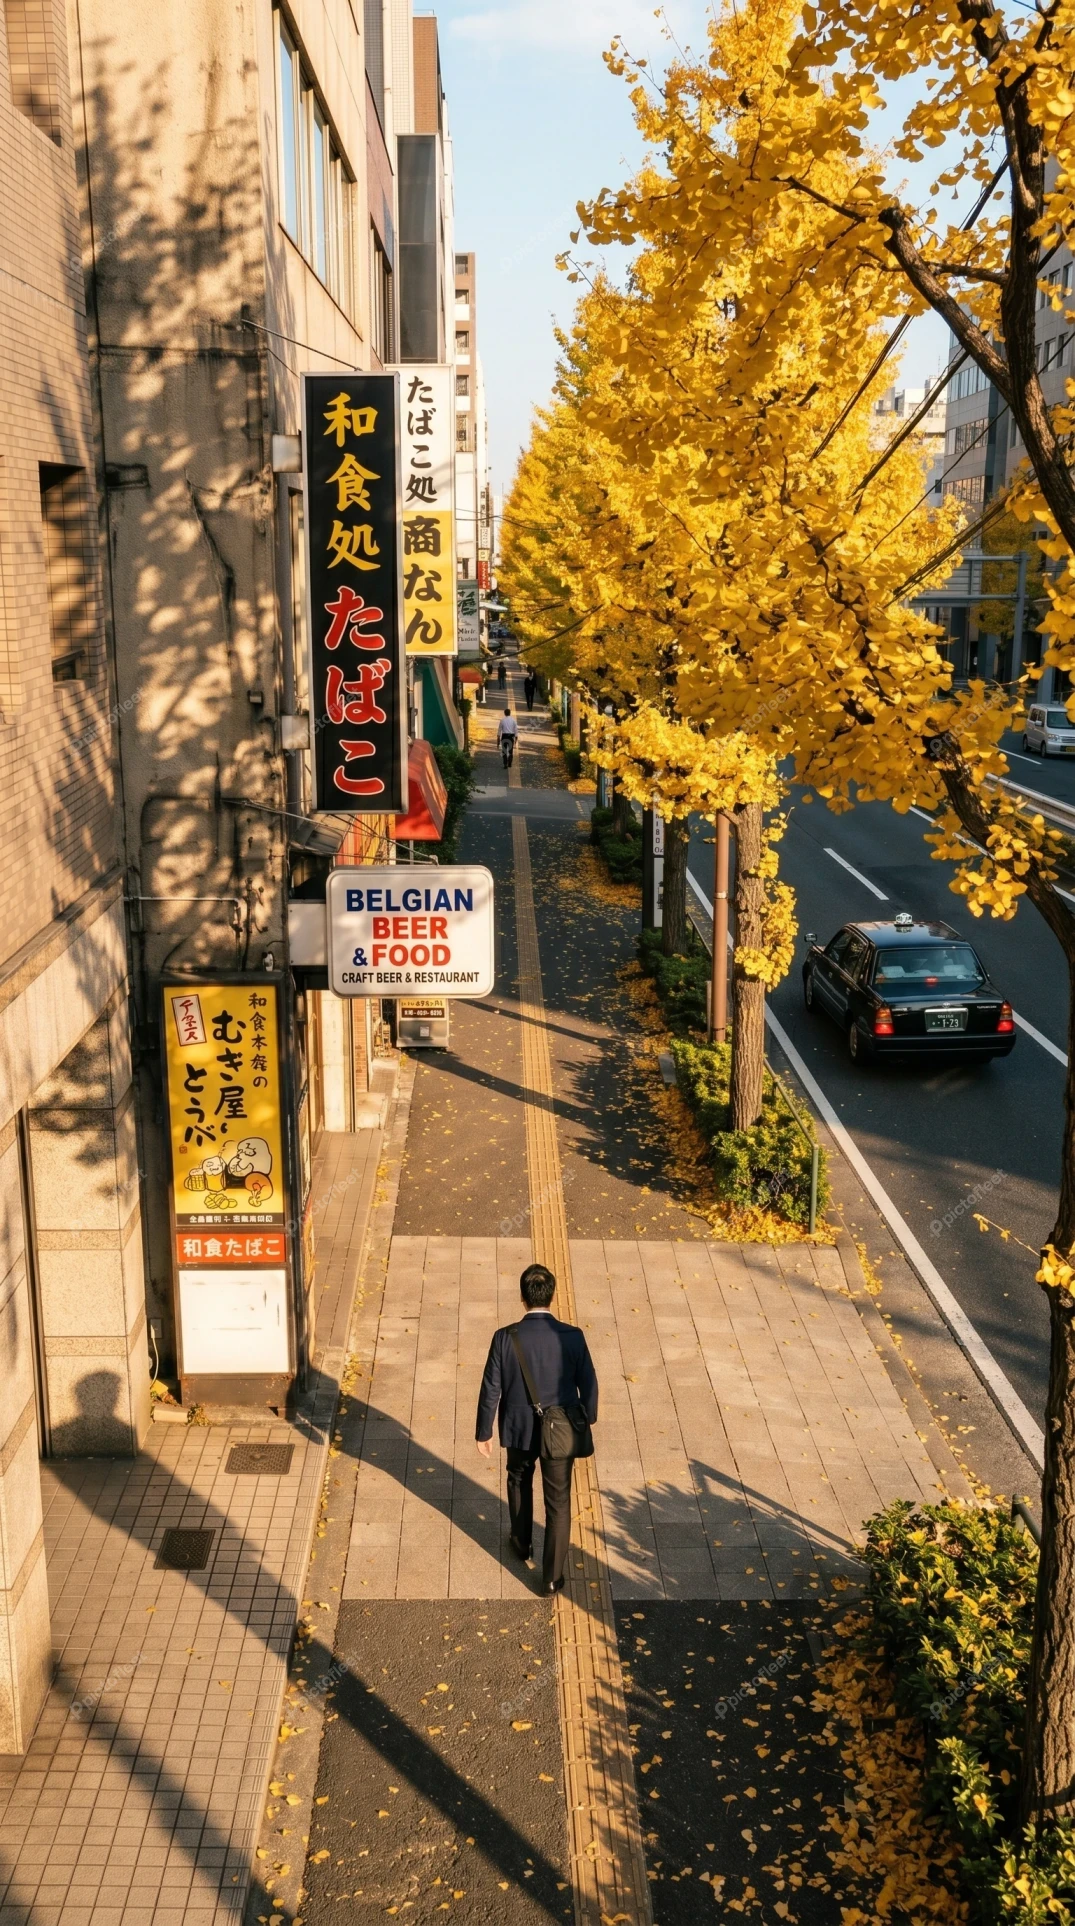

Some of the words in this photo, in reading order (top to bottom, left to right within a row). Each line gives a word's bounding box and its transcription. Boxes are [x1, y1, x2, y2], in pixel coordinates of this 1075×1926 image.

[405, 375, 437, 504] たばこ処
[346, 888, 474, 912] BELGIAN
[372, 916, 449, 940] BEER
[352, 947, 368, 967] &
[372, 943, 451, 967] FOOD
[341, 972, 374, 984] CRAFT
[376, 972, 402, 984] BEER
[405, 972, 413, 983] &
[414, 971, 480, 983] RESTAURANT
[183, 1237, 281, 1258] 和食たばこ
